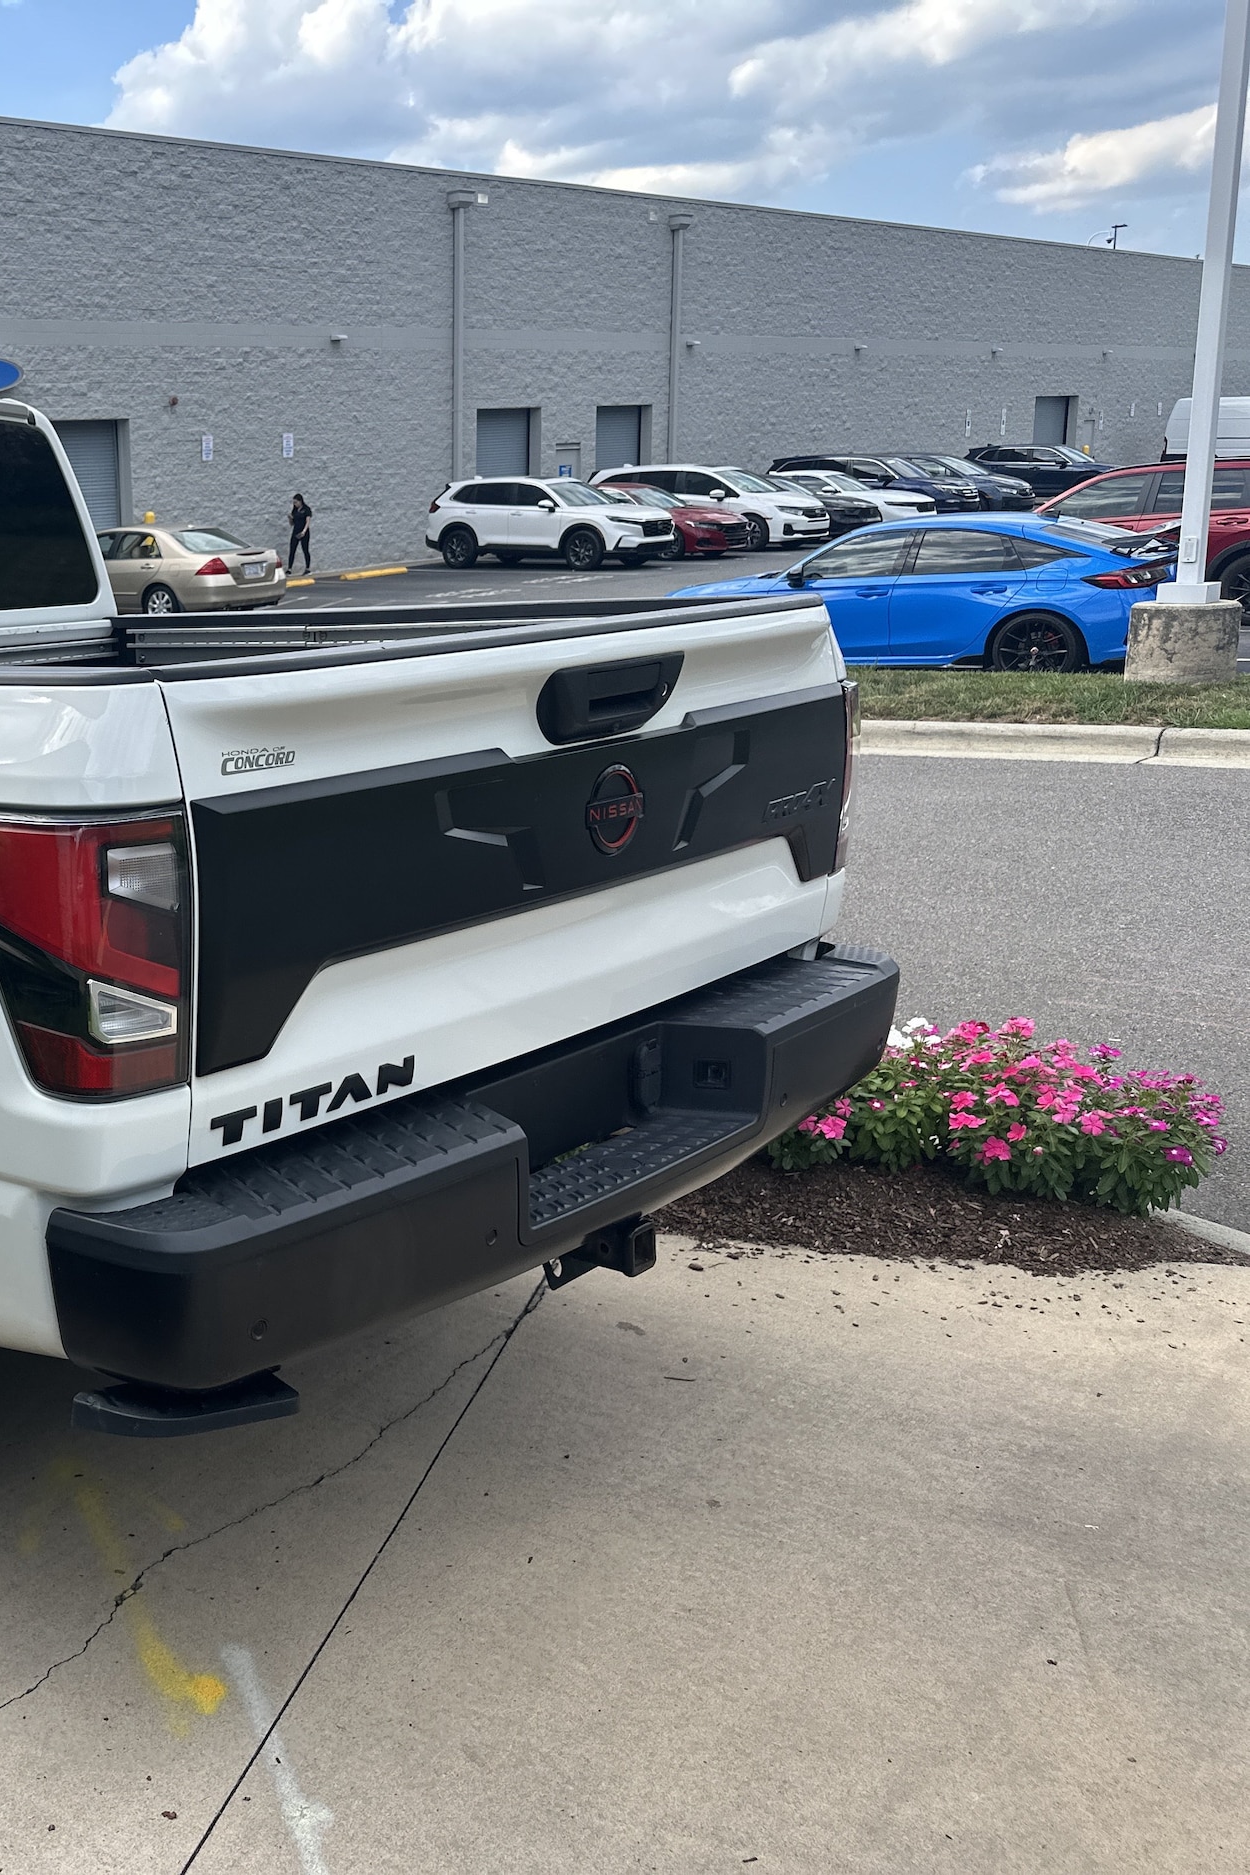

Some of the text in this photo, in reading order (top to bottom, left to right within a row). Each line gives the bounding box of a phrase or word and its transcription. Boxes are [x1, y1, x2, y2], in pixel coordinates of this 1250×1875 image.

[221, 747, 269, 757] HONDA
[221, 750, 296, 776] CONCORD
[590, 799, 643, 822] NISSAN
[210, 1055, 415, 1147] TITAN
